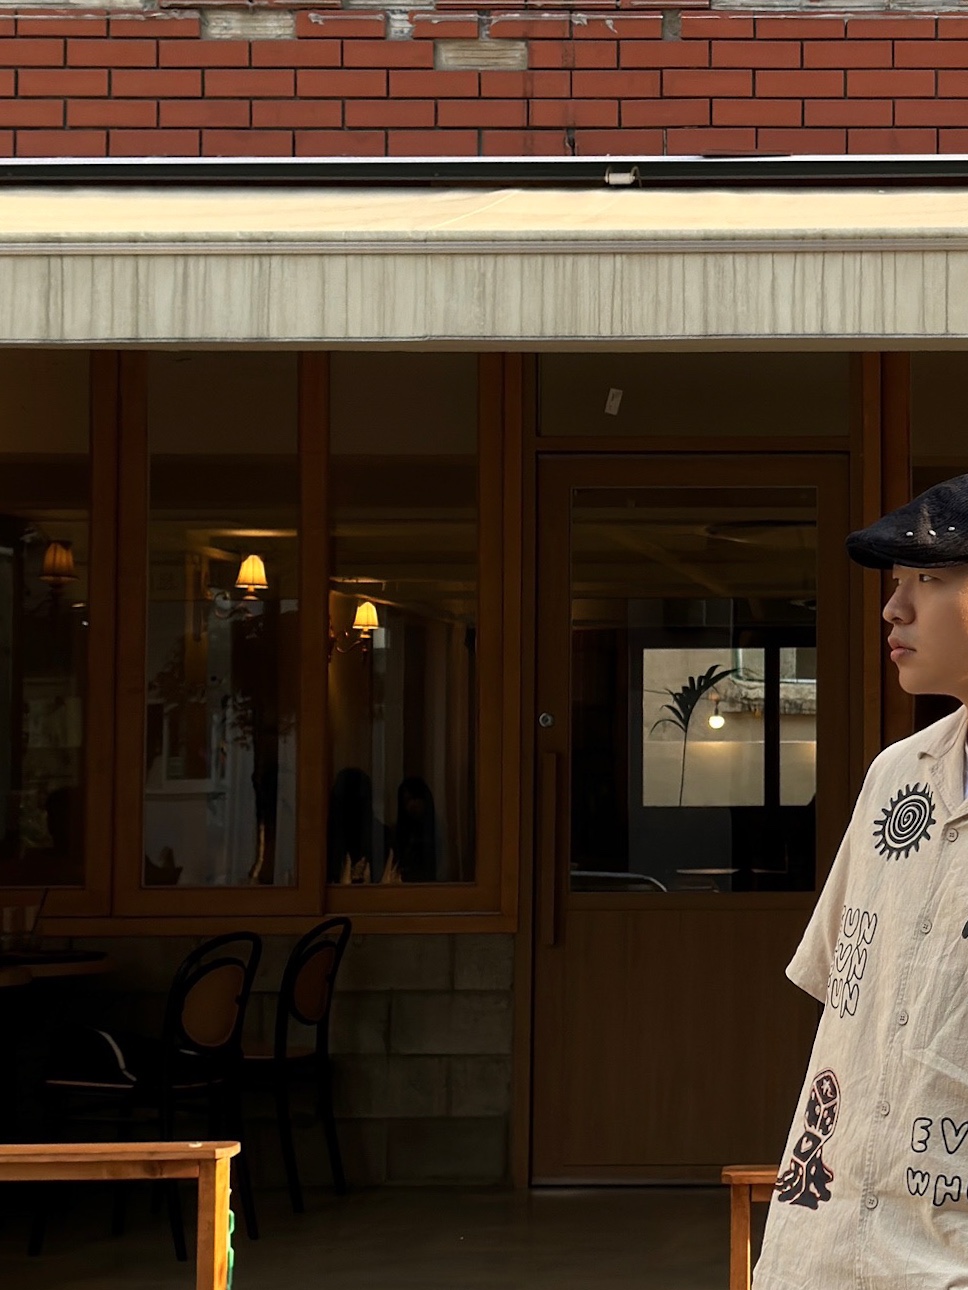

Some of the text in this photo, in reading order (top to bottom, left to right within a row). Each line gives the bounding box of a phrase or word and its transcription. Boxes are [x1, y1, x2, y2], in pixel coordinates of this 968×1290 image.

[841, 905, 878, 945] UN
[832, 943, 868, 981] UN
[827, 977, 860, 1019] UN
